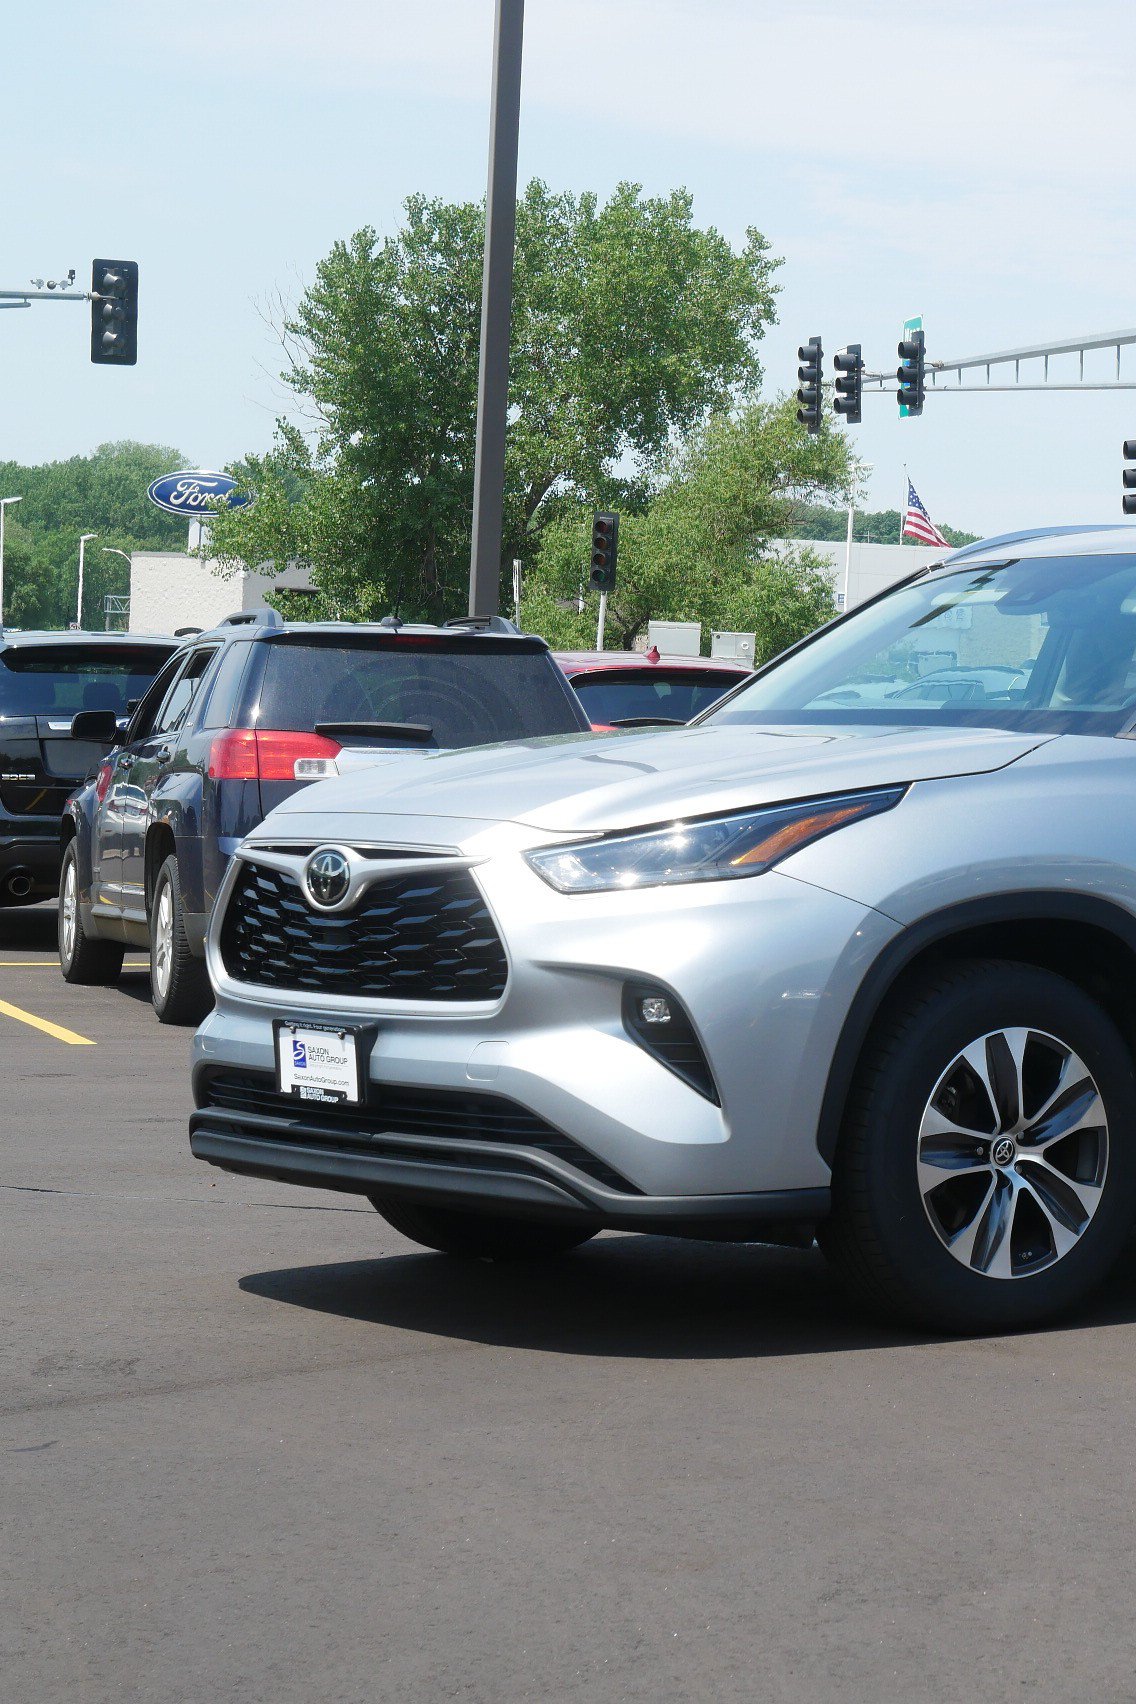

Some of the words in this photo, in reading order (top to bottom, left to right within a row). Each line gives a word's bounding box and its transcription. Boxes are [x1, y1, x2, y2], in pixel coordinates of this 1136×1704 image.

[169, 479, 233, 506] Ford
[308, 1046, 329, 1055] SAXON
[308, 1055, 325, 1063] AUTO
[326, 1056, 348, 1065] GROUP
[294, 1073, 350, 1085] SaxonAutoGroup.com
[307, 1093, 320, 1101] AUTO
[321, 1094, 339, 1103] GROUP
